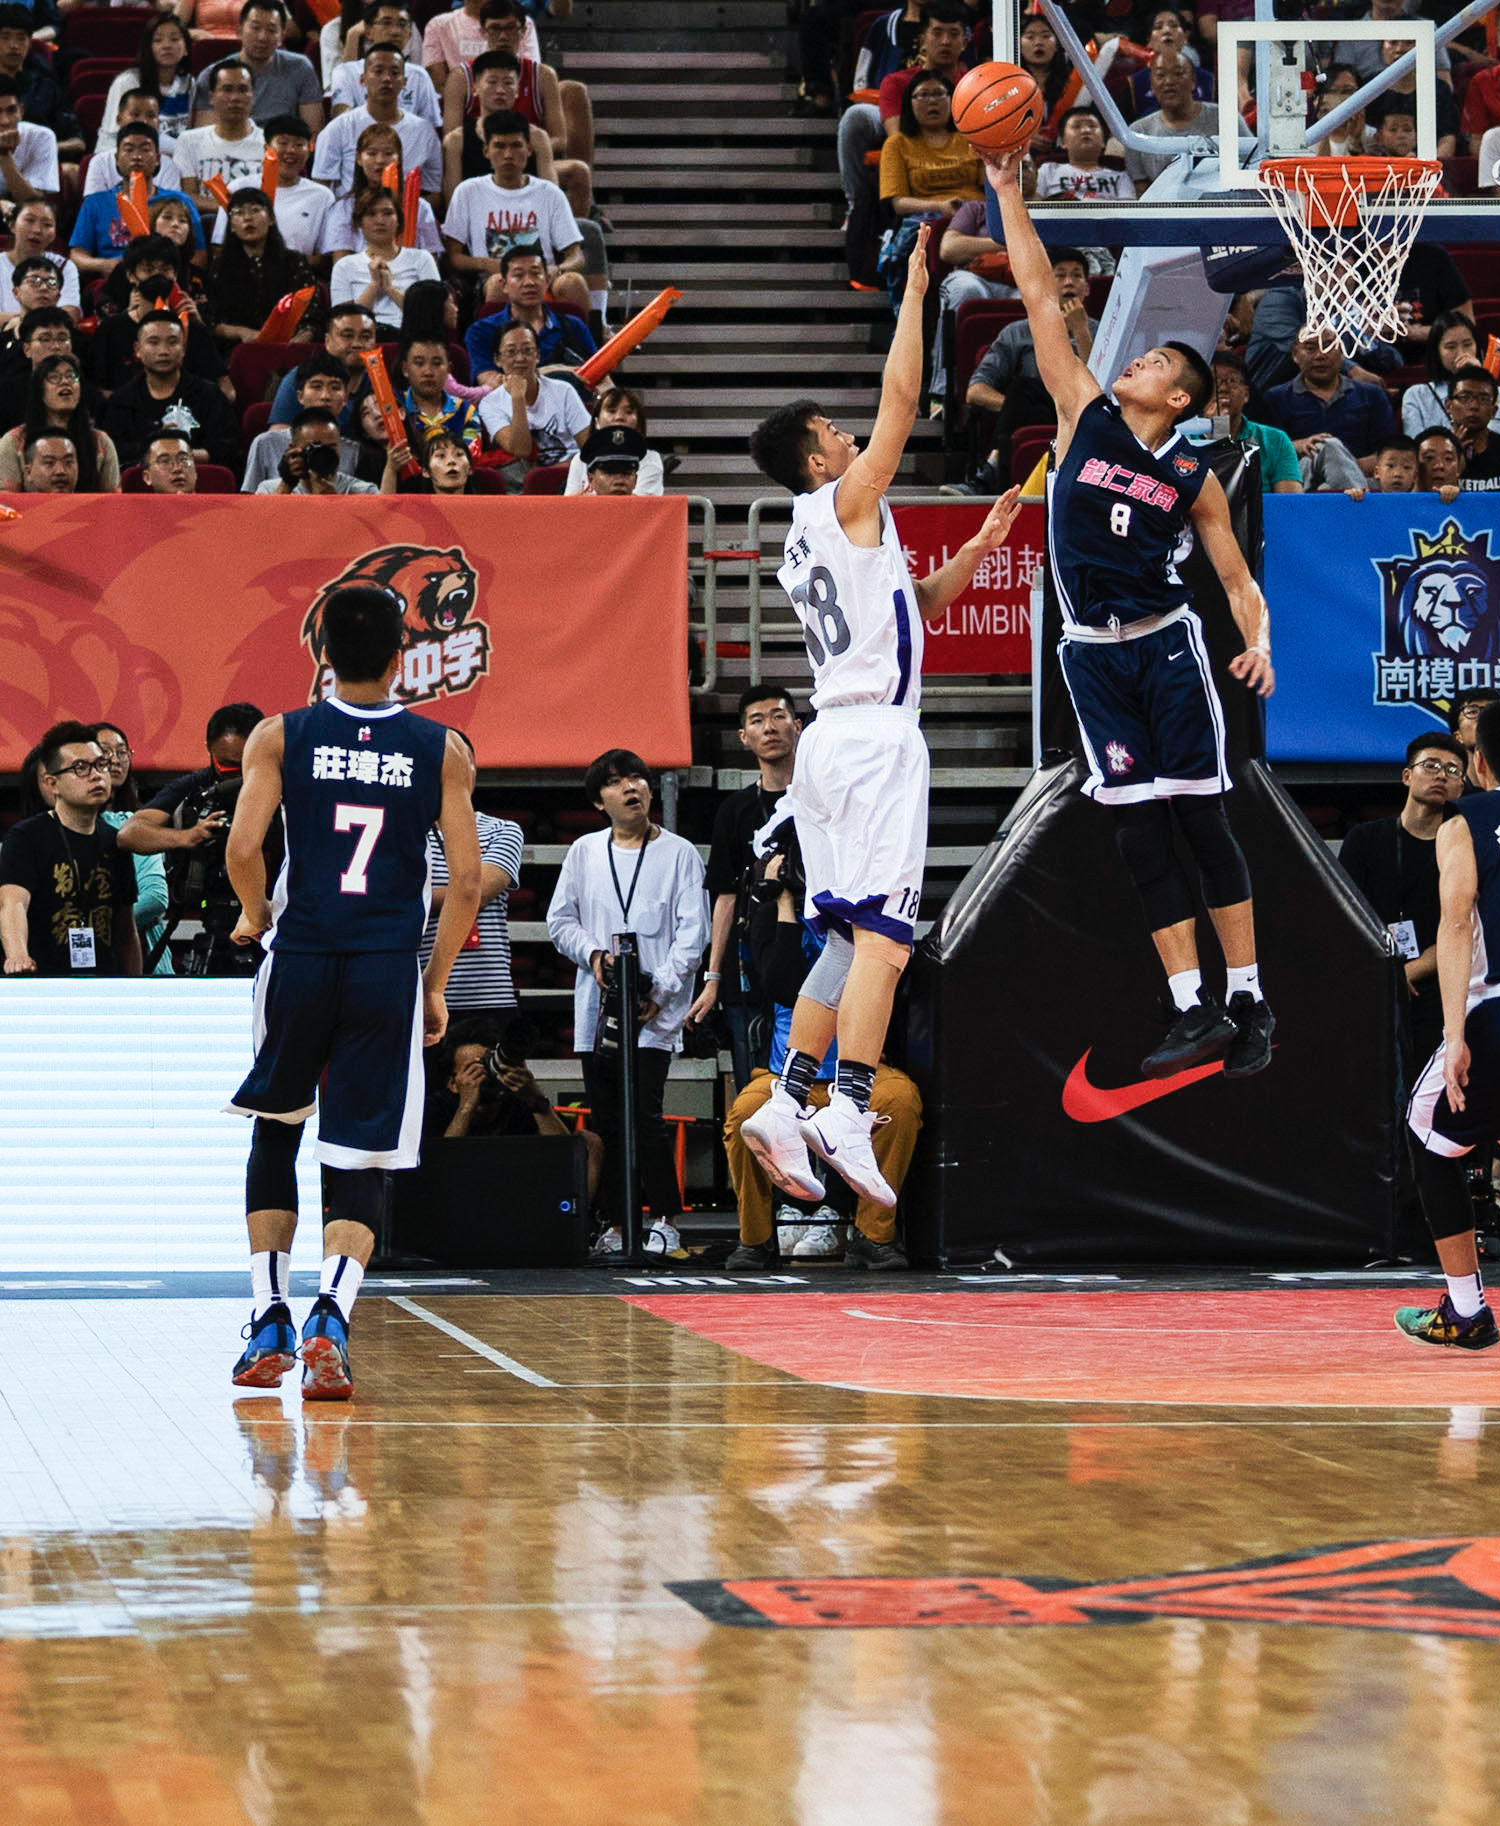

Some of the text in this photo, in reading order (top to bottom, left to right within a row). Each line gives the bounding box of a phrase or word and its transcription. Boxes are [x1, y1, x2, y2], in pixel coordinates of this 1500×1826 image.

[1060, 175, 1121, 194] EVERY
[1076, 457, 1179, 512] 能仁家商
[1110, 502, 1132, 537] 8
[321, 628, 483, 701] 中学
[333, 802, 385, 895] 7
[898, 886, 920, 919] 18
